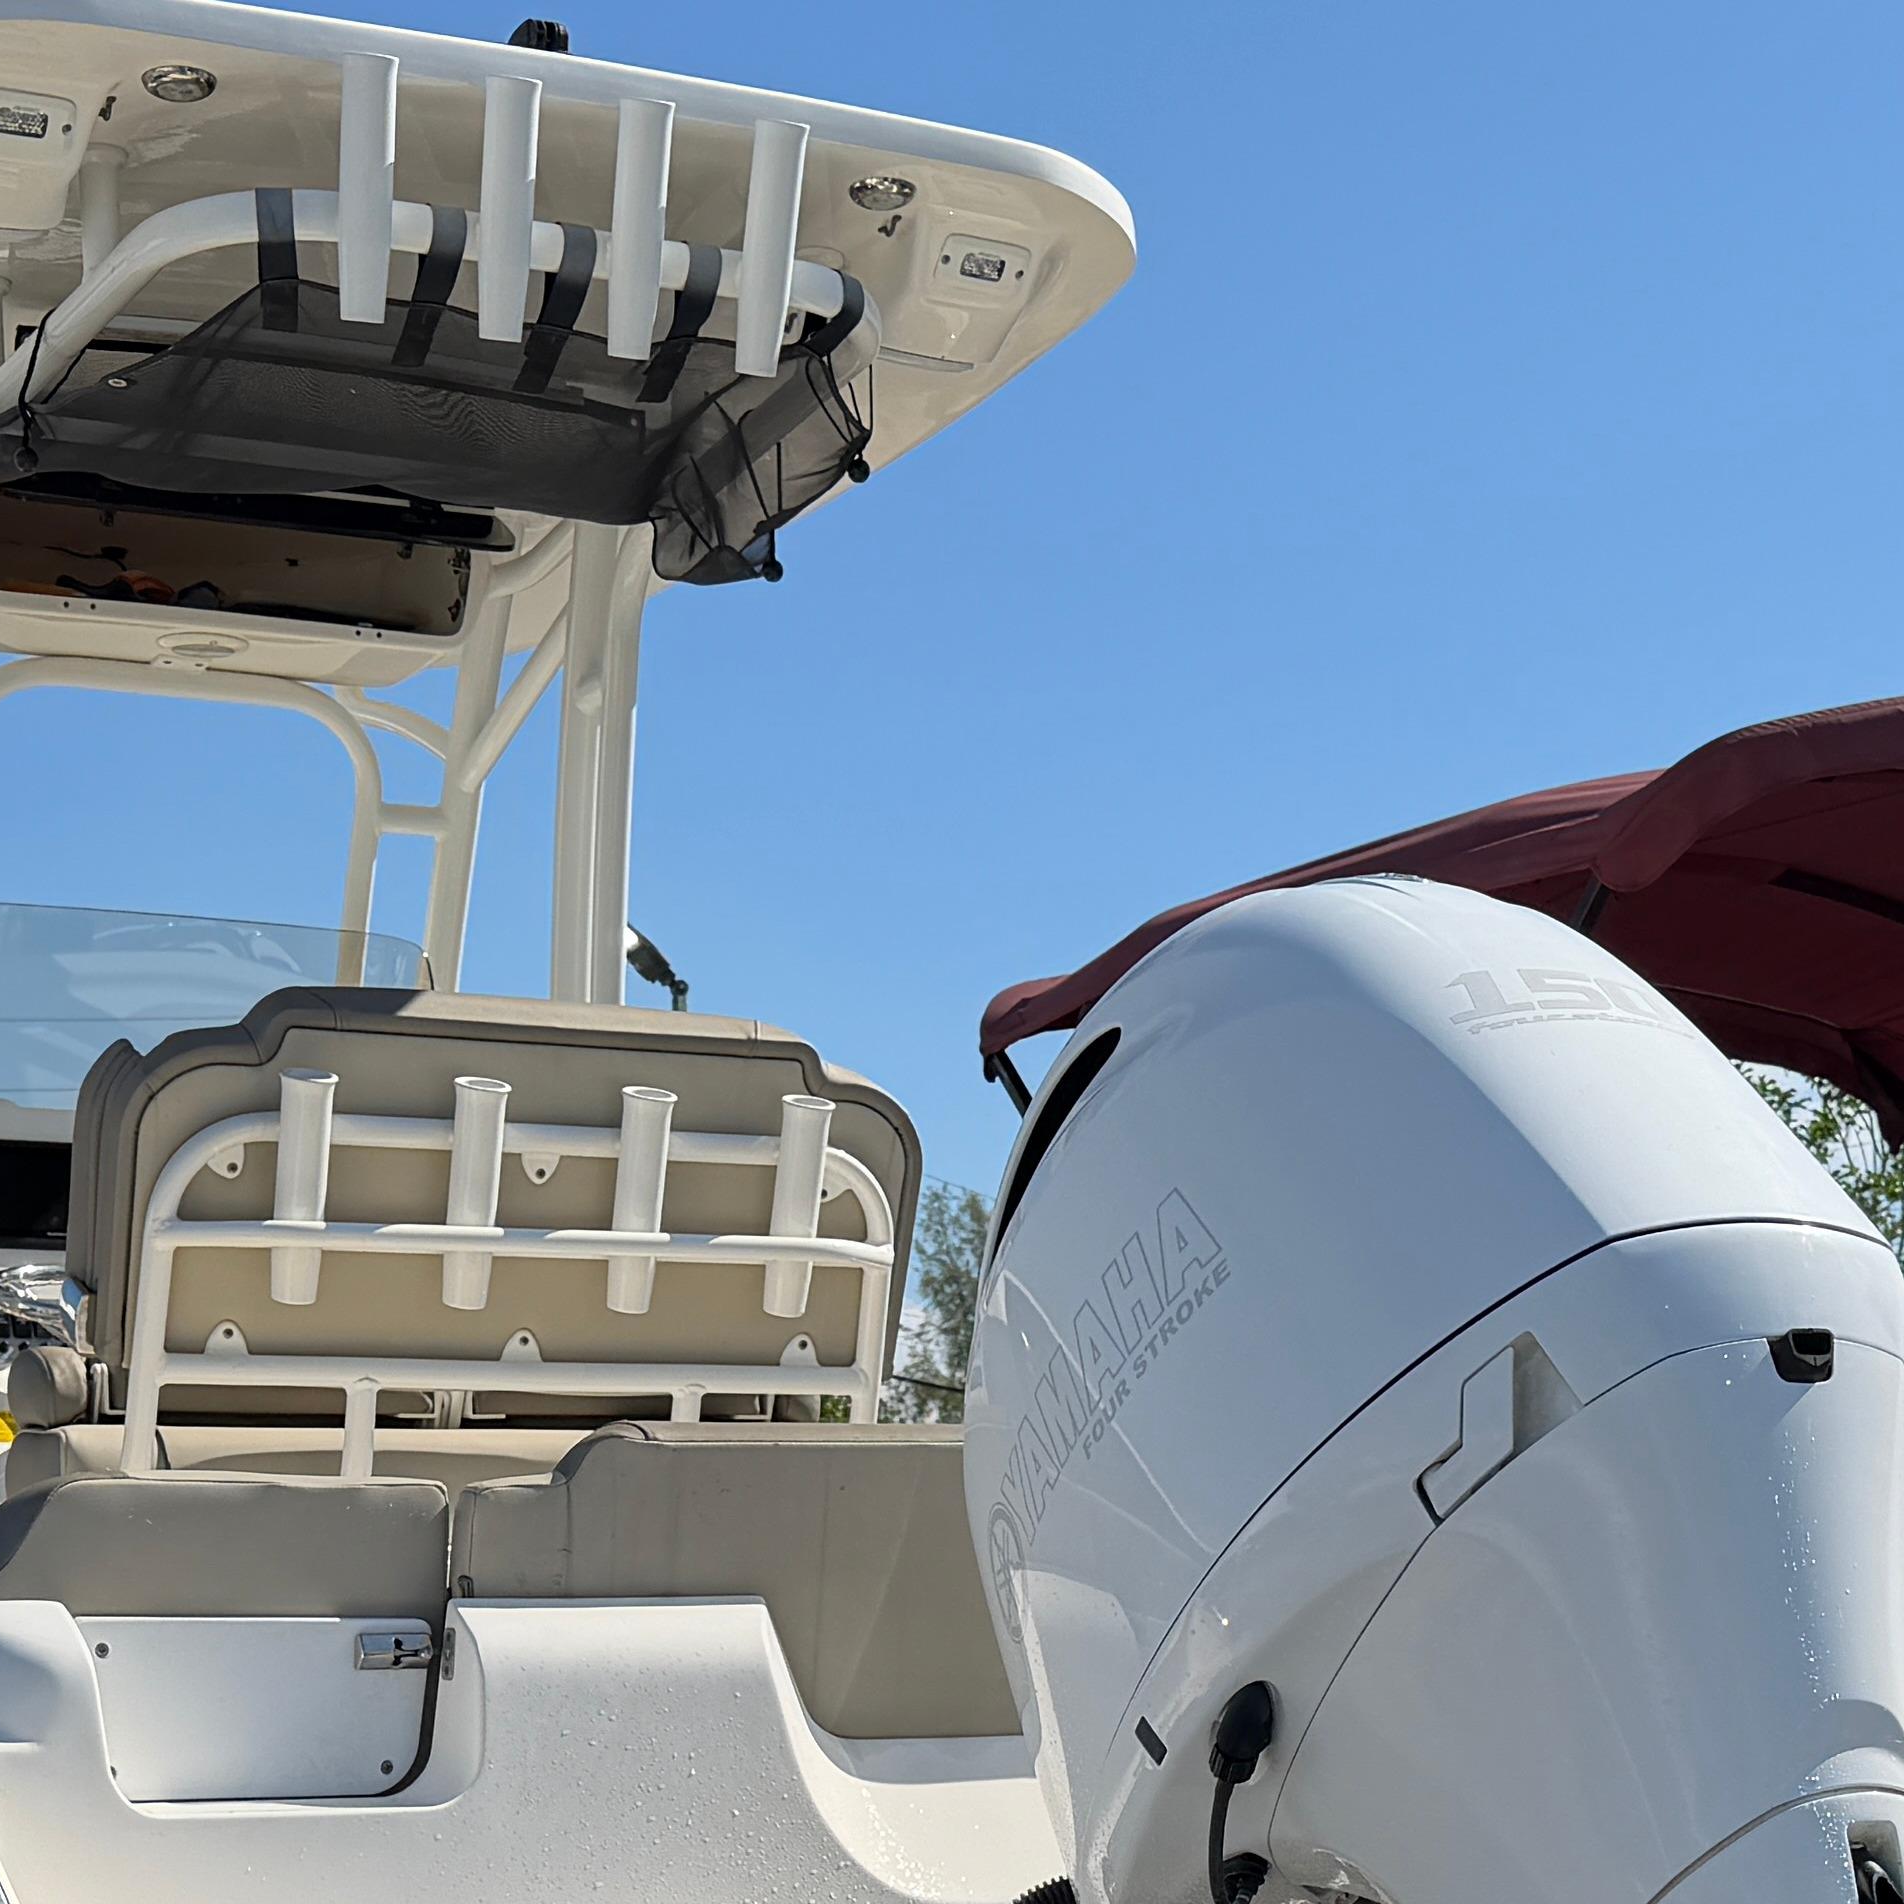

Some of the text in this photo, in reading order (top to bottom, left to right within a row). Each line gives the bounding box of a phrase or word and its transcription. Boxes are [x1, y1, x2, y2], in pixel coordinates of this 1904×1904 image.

[1444, 968, 1680, 1025] 150
[1000, 1186, 1223, 1546] YAMAHA
[1082, 1258, 1232, 1460] FOUR STROKE
